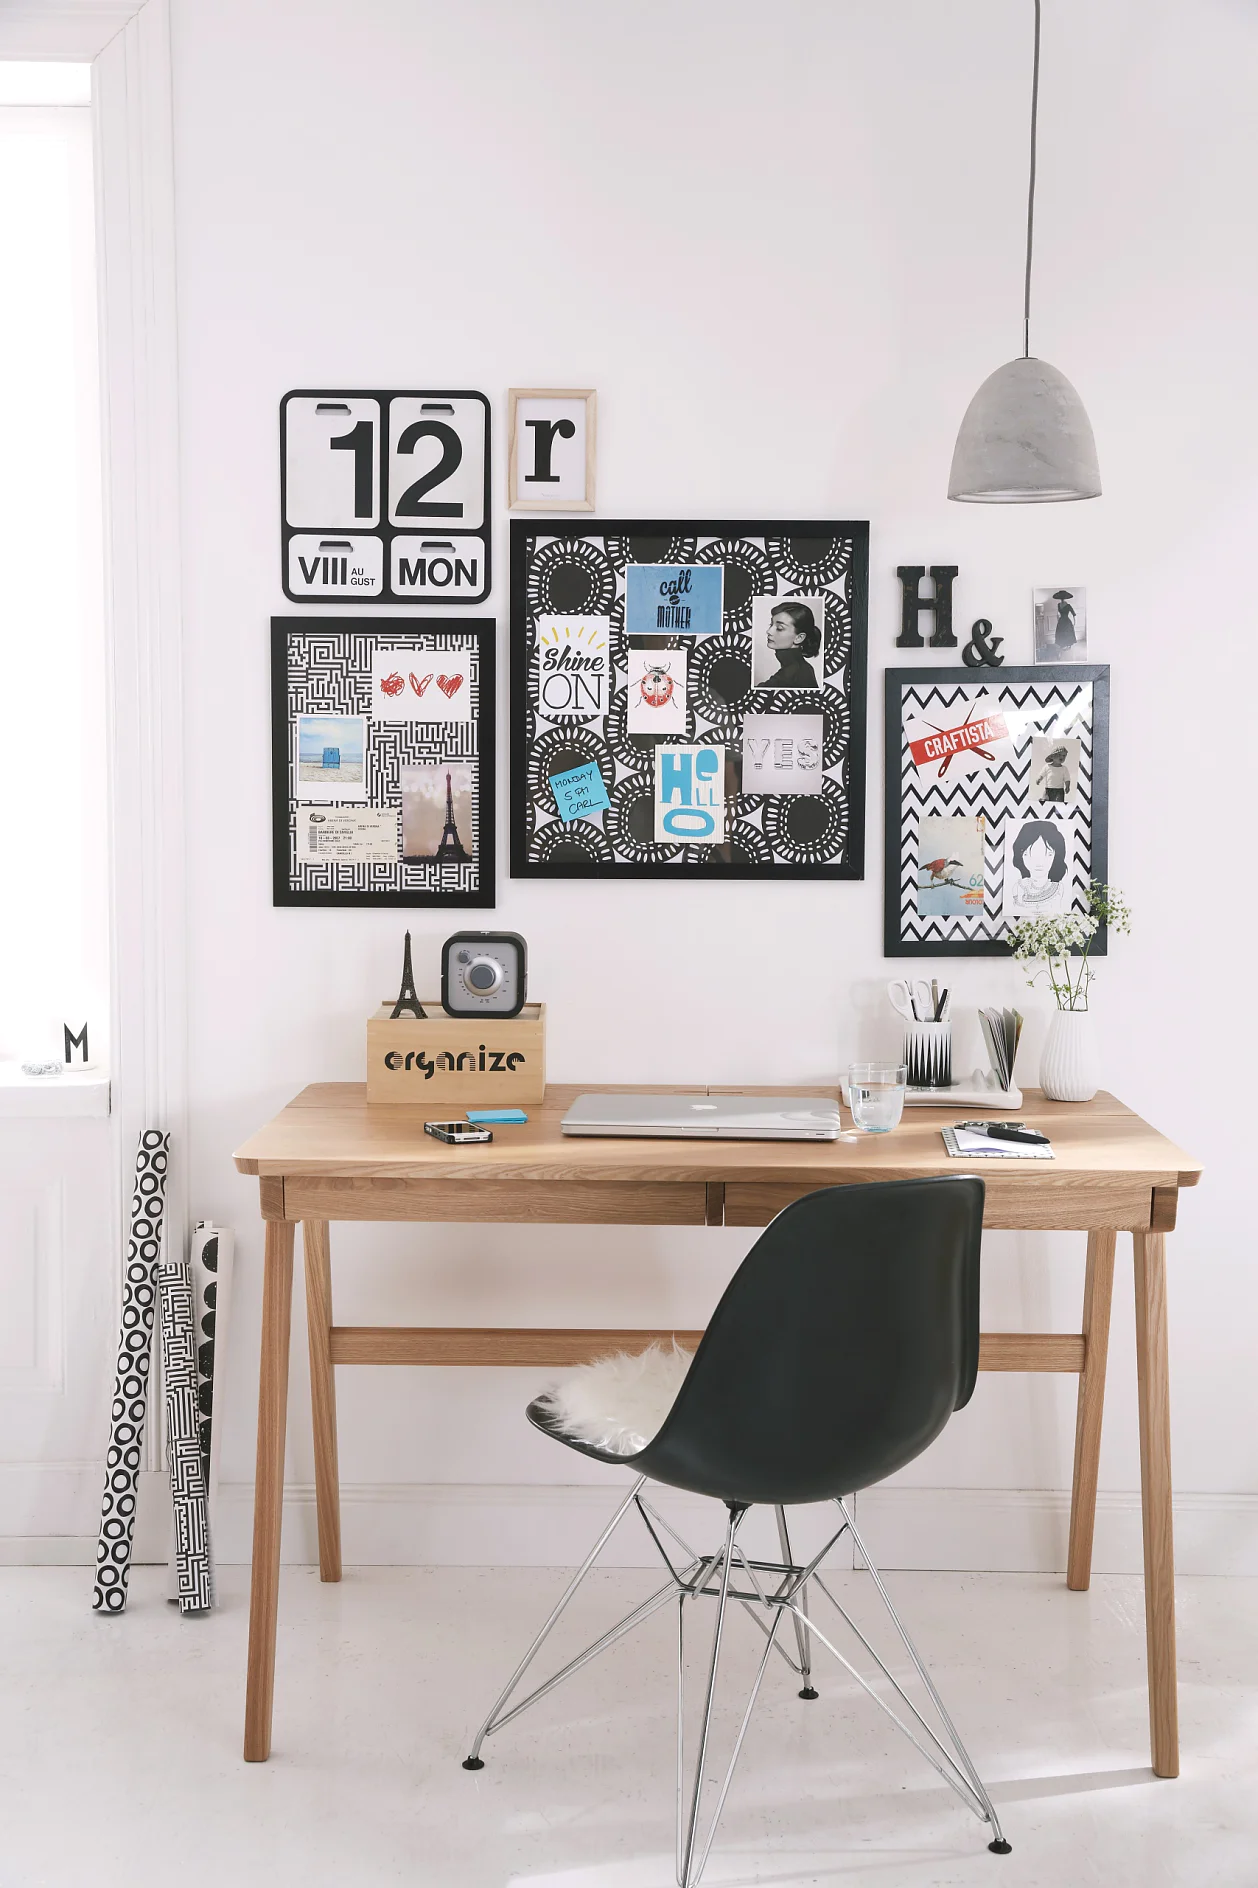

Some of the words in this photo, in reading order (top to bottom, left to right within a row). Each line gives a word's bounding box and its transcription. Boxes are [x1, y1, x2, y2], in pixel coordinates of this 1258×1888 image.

[524, 419, 576, 483] r
[297, 556, 348, 586] VIII
[399, 557, 478, 587] MON
[659, 569, 693, 596] call
[656, 605, 692, 629] MOTHER
[896, 565, 959, 648] H
[542, 644, 605, 672] Shine
[542, 673, 605, 710] ON
[747, 738, 820, 771] YES
[924, 721, 994, 758] CRAFTISTA
[554, 769, 593, 789] MONDAY
[574, 786, 589, 797] PM
[568, 798, 604, 815] CARL
[968, 873, 984, 887] 62
[63, 1021, 89, 1064] M
[384, 1044, 526, 1079] organize
